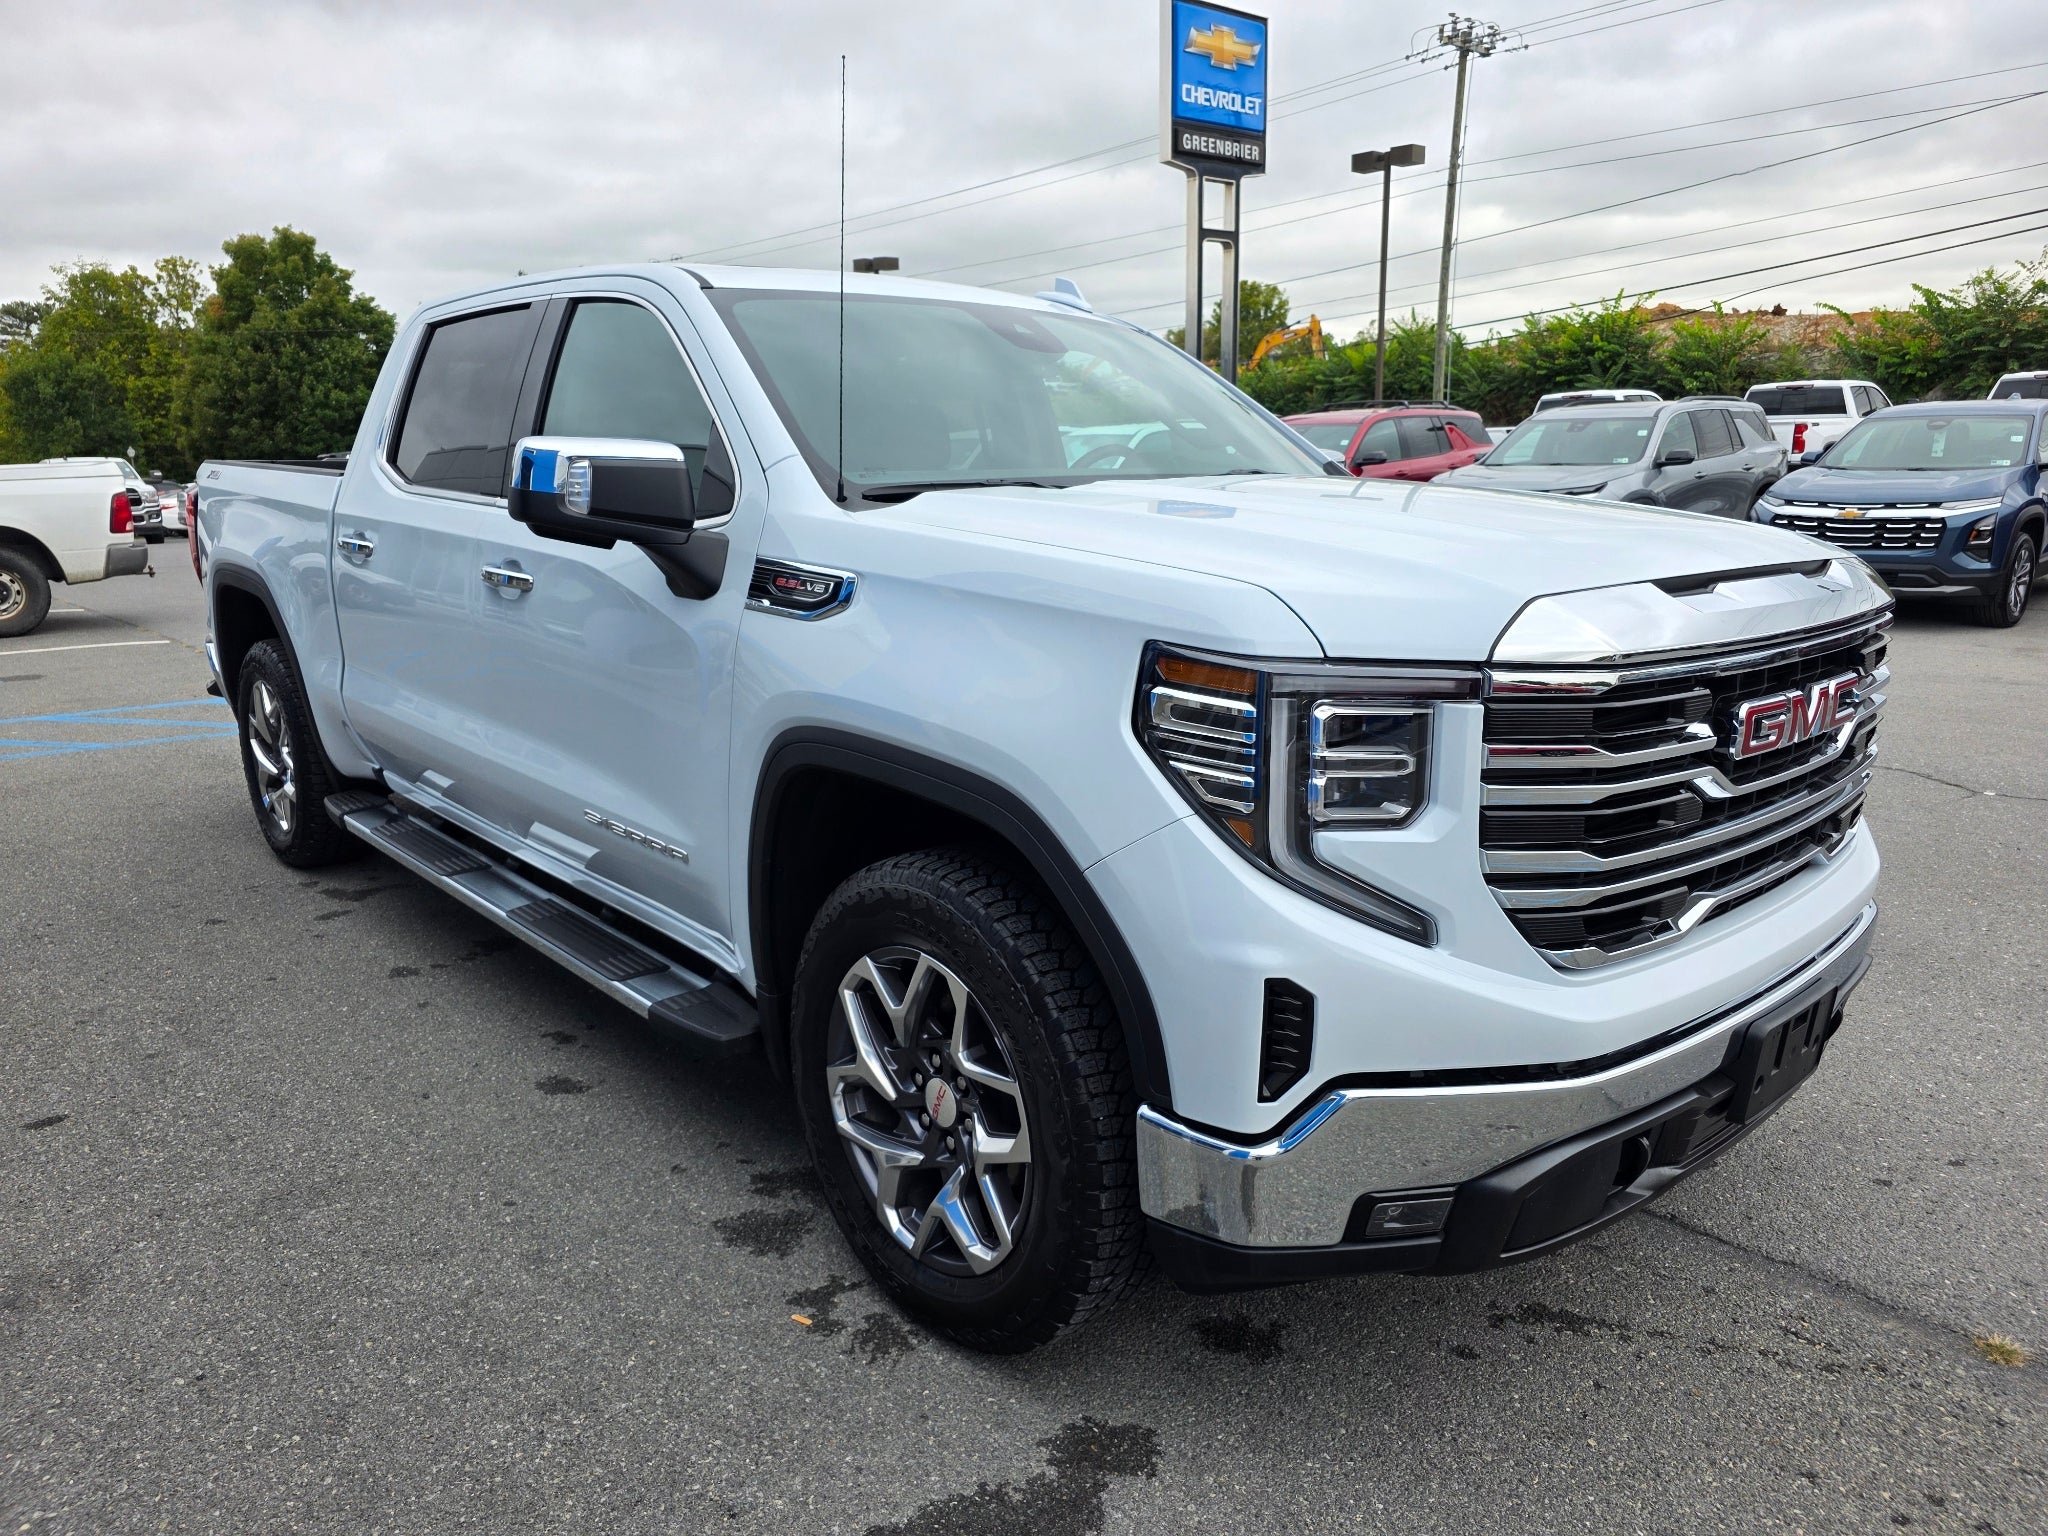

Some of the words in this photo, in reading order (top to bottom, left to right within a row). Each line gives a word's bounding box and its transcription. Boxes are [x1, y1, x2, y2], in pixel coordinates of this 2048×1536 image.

[1182, 83, 1261, 115] CHEVROLET
[1183, 133, 1260, 160] GREENBRIER
[1731, 671, 1859, 760] GMC
[584, 808, 690, 864] SIERRA
[931, 1085, 947, 1121] GMC
